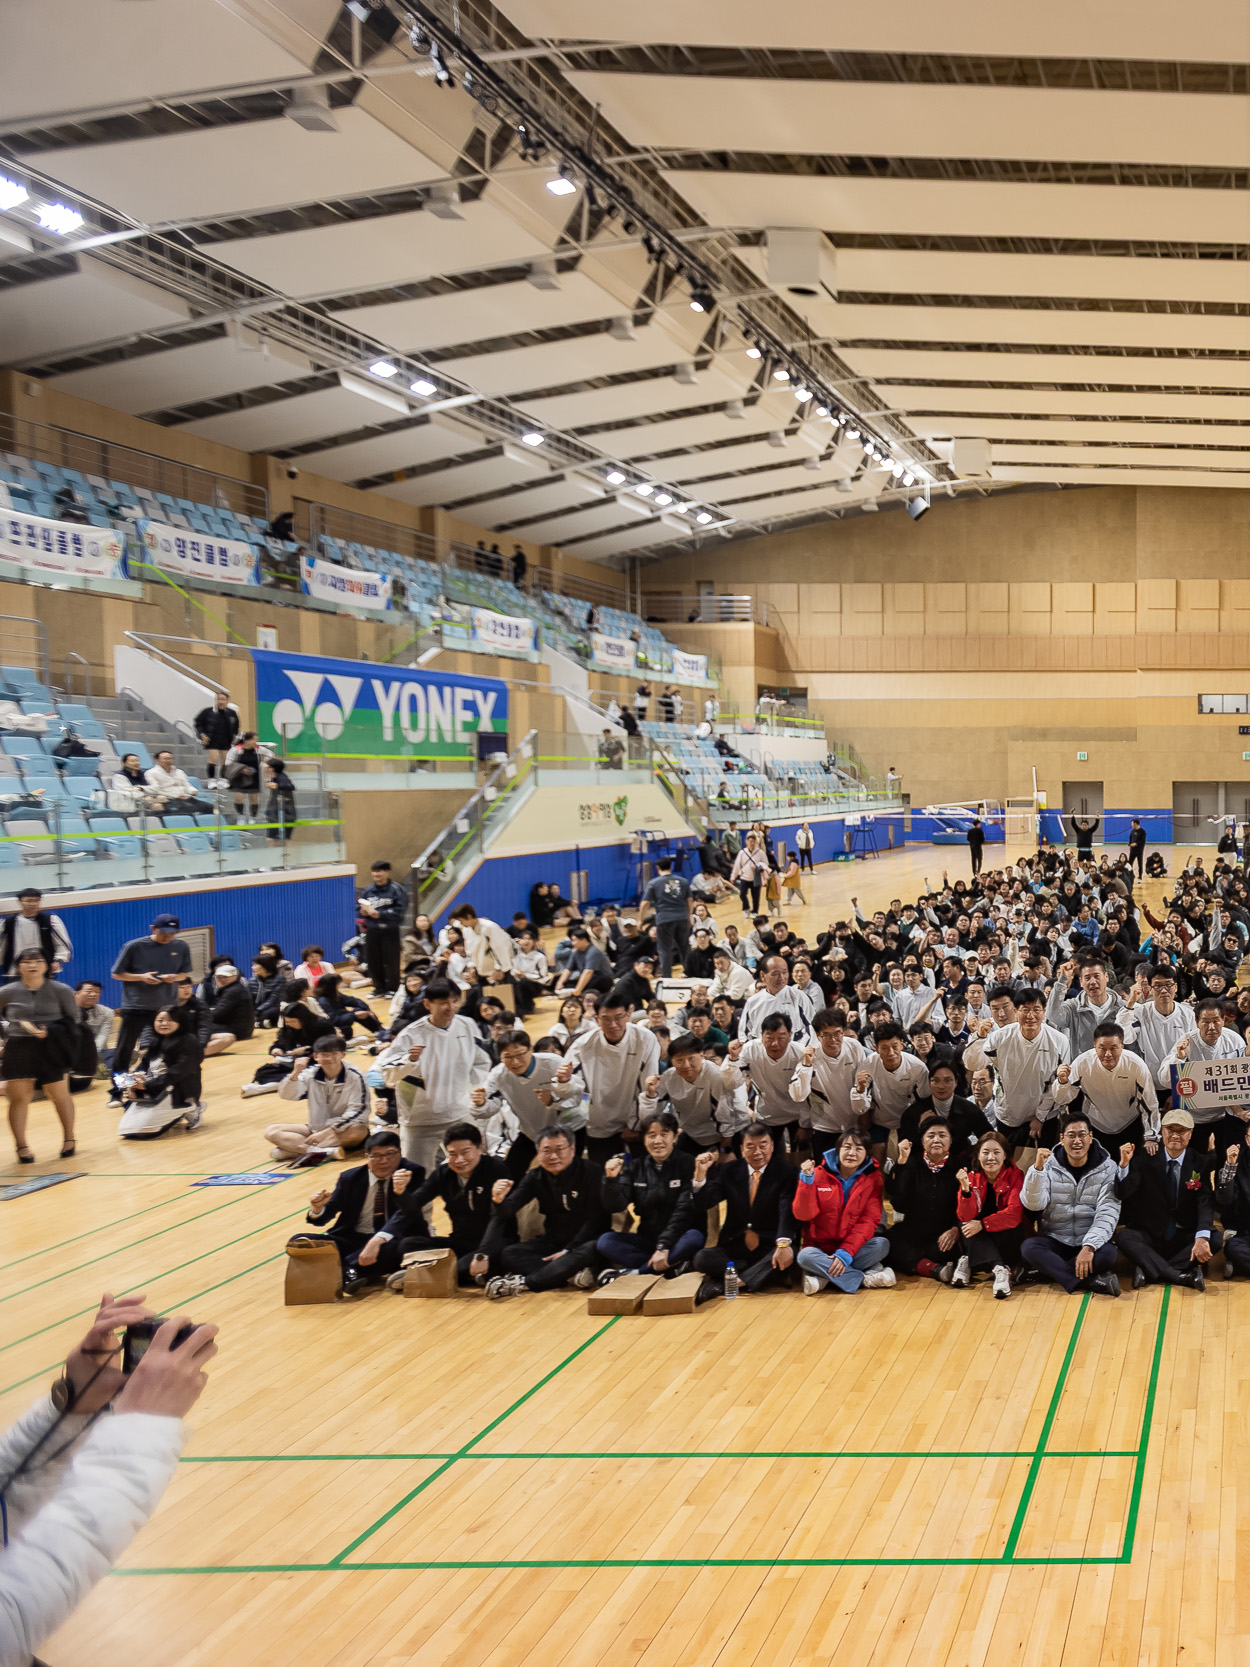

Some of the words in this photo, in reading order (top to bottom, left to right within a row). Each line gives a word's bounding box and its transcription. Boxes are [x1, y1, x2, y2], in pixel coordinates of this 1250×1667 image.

[370, 678, 499, 744] YONEX
[1204, 1064, 1238, 1077] 제31회
[1179, 1081, 1193, 1095] 필
